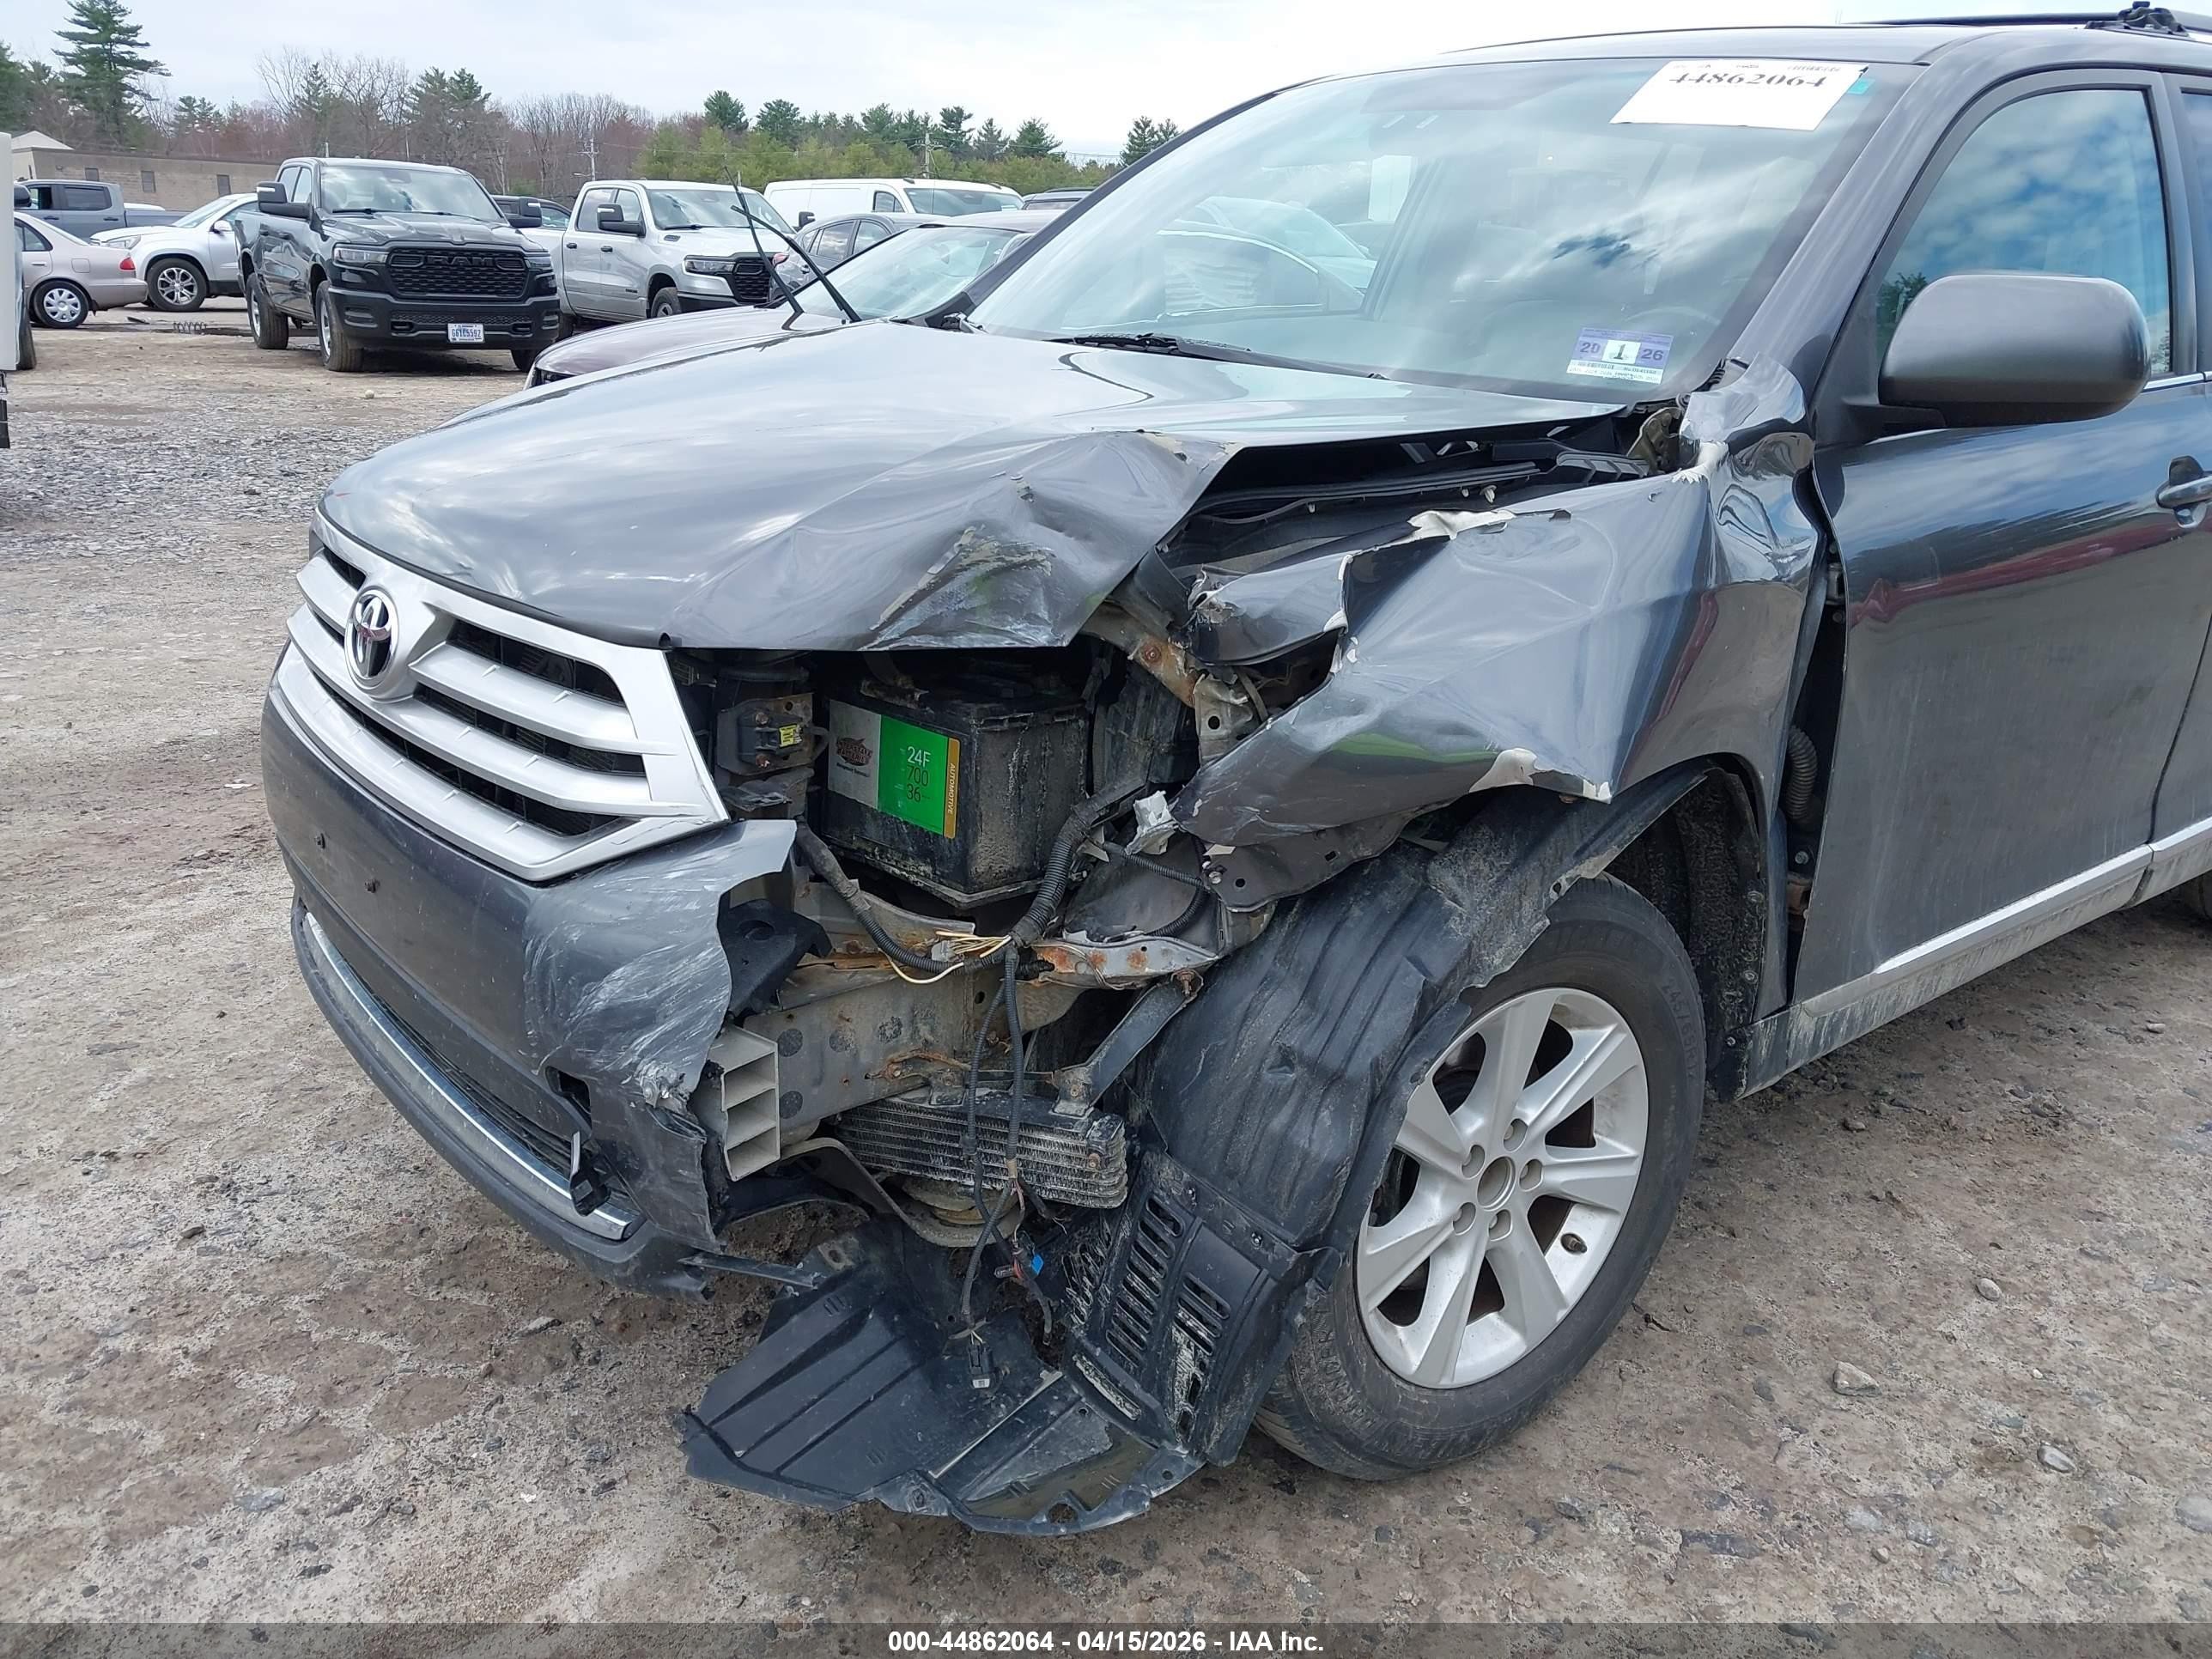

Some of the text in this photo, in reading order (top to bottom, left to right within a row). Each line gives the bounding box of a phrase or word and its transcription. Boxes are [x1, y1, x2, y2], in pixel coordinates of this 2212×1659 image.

[1668, 72, 1828, 88] 44862064
[428, 255, 494, 266] RAM
[1580, 342, 1664, 362] 20 1 26
[907, 745, 932, 768] 24F
[907, 764, 929, 787] 700
[906, 783, 921, 803] 36
[947, 763, 956, 815] AUTOMOTIVE
